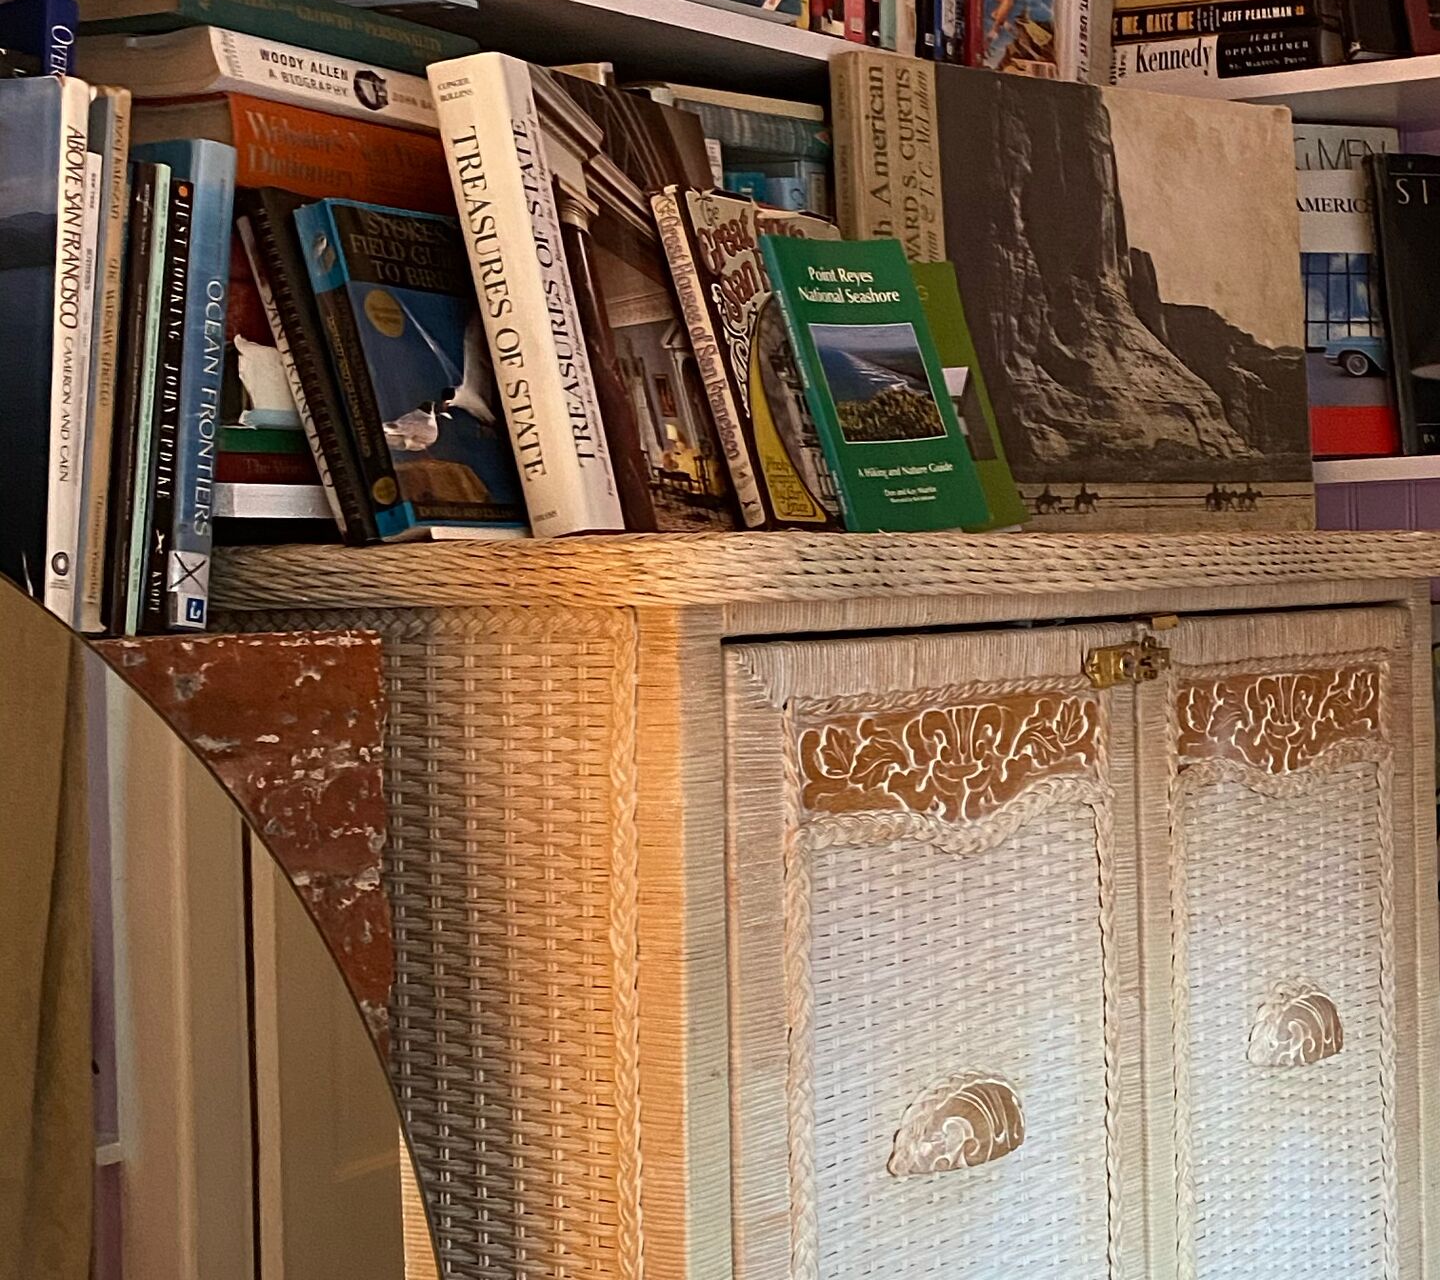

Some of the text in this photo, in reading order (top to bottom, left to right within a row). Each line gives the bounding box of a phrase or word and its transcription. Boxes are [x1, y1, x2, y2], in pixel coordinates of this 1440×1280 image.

[1079, 15, 1090, 41] USE
[1146, 12, 1174, 34] HATE
[1177, 10, 1195, 30] ME
[1222, 9, 1242, 23] JEFF
[1245, 5, 1293, 21] PEARLMAN
[50, 24, 75, 76] OVER
[365, 23, 442, 53] PERSONALITY
[1078, 44, 1089, 58] IT
[1136, 37, 1212, 76] Kennedy
[1225, 40, 1310, 56] OPPENHEIMER
[1250, 31, 1285, 43] JERRY
[259, 48, 349, 82] WOODY ALLEN
[268, 68, 351, 98] A BIOGRAPHY
[1117, 50, 1128, 80] Mrs.
[895, 68, 918, 190] S. CURTIS
[913, 70, 931, 149] McLuhan
[245, 109, 338, 156] Webster's
[865, 65, 893, 207] American
[247, 142, 346, 186] Dictionary
[59, 124, 86, 329] ABOVE SAN FRANCISCO
[350, 233, 404, 262] FIELD
[697, 208, 757, 277] Great
[167, 200, 191, 340] JUST LOOKING
[372, 259, 401, 282] TO
[719, 258, 760, 322] San
[808, 266, 875, 287] Point Reyes
[451, 124, 548, 482] TREASURES OF STATE
[509, 118, 596, 468] TREASURES OF STATE
[798, 286, 901, 305] National Seashore
[659, 214, 739, 461] Great Houses of San Francisco
[57, 336, 74, 483] CAMERON AND CAEN
[192, 280, 226, 537] OCEAN FRONTIERS
[264, 294, 336, 489] SAN FRANCISCO
[156, 363, 180, 500] JOHN UPDIKE
[1423, 433, 1436, 444] BY
[865, 462, 954, 479] Hiking and Nature Guide
[149, 571, 163, 613] KNOPF
